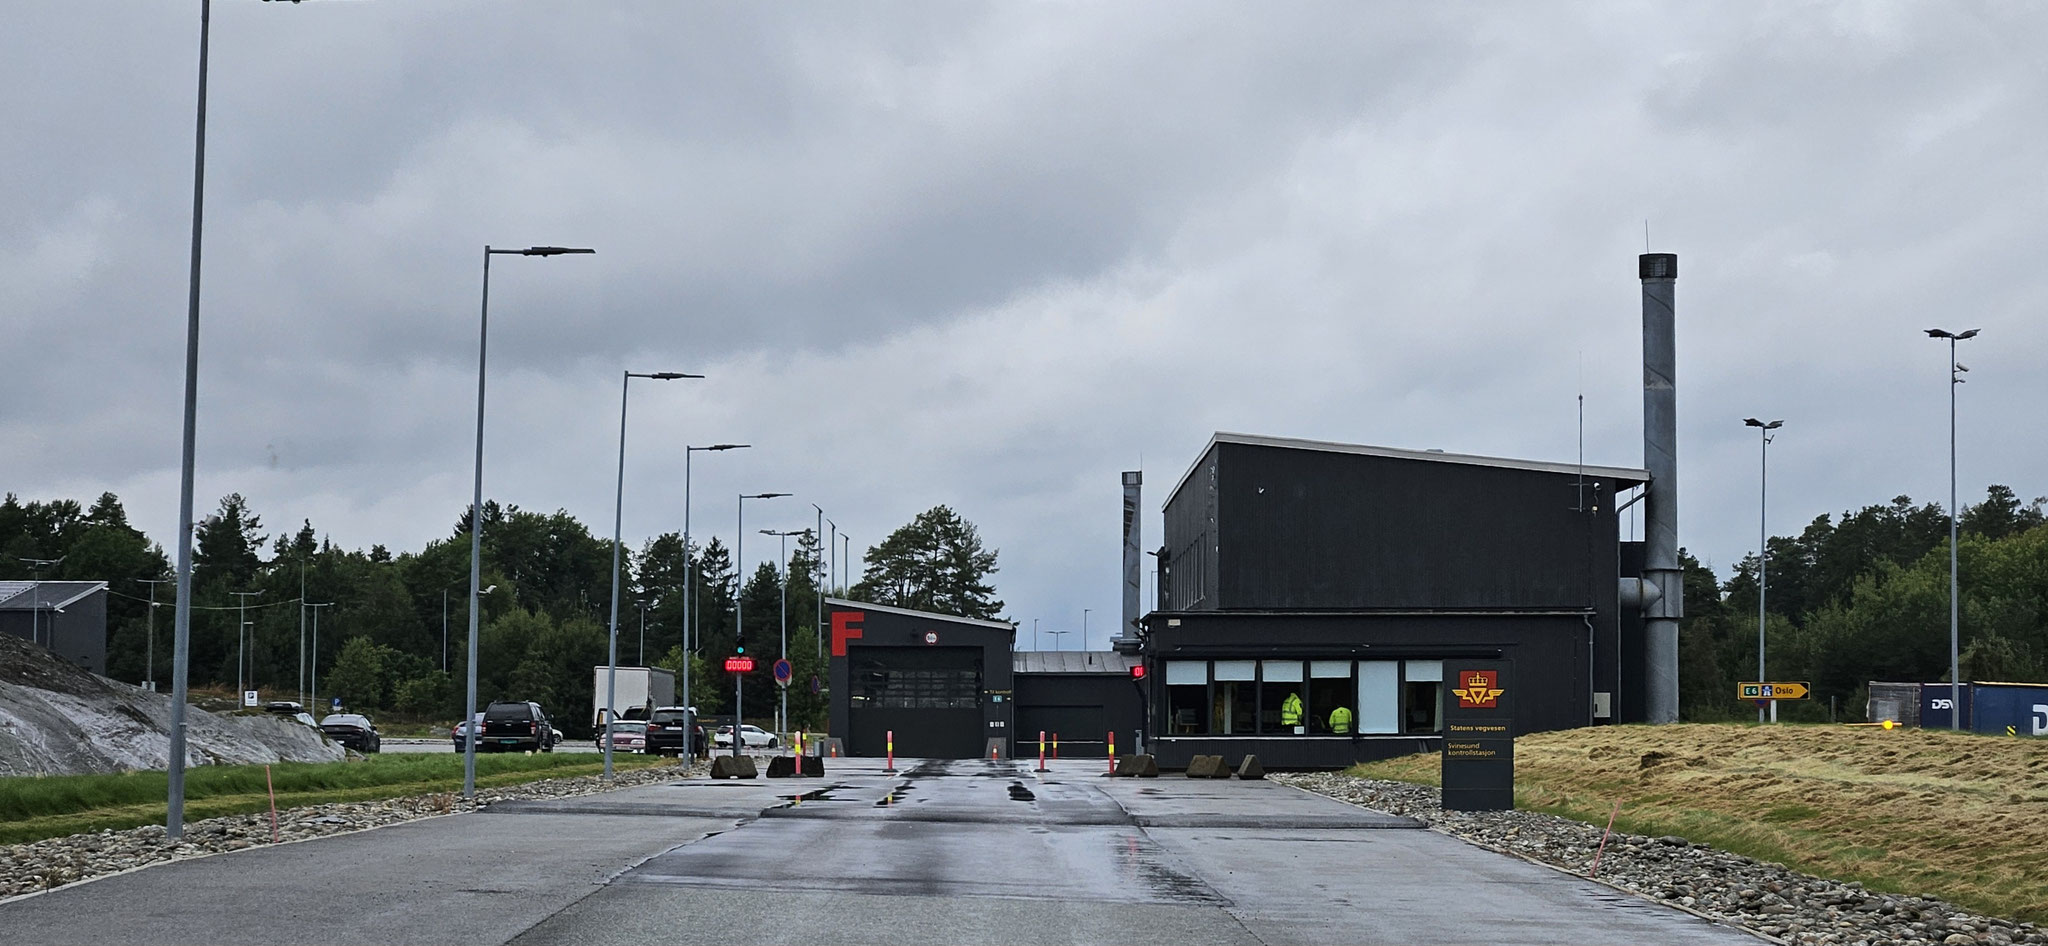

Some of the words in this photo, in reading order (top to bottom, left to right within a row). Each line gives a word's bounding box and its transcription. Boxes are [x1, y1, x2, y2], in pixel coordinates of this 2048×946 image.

[832, 612, 865, 656] F
[727, 660, 752, 671] 00000
[1775, 686, 1794, 695] Oslo
